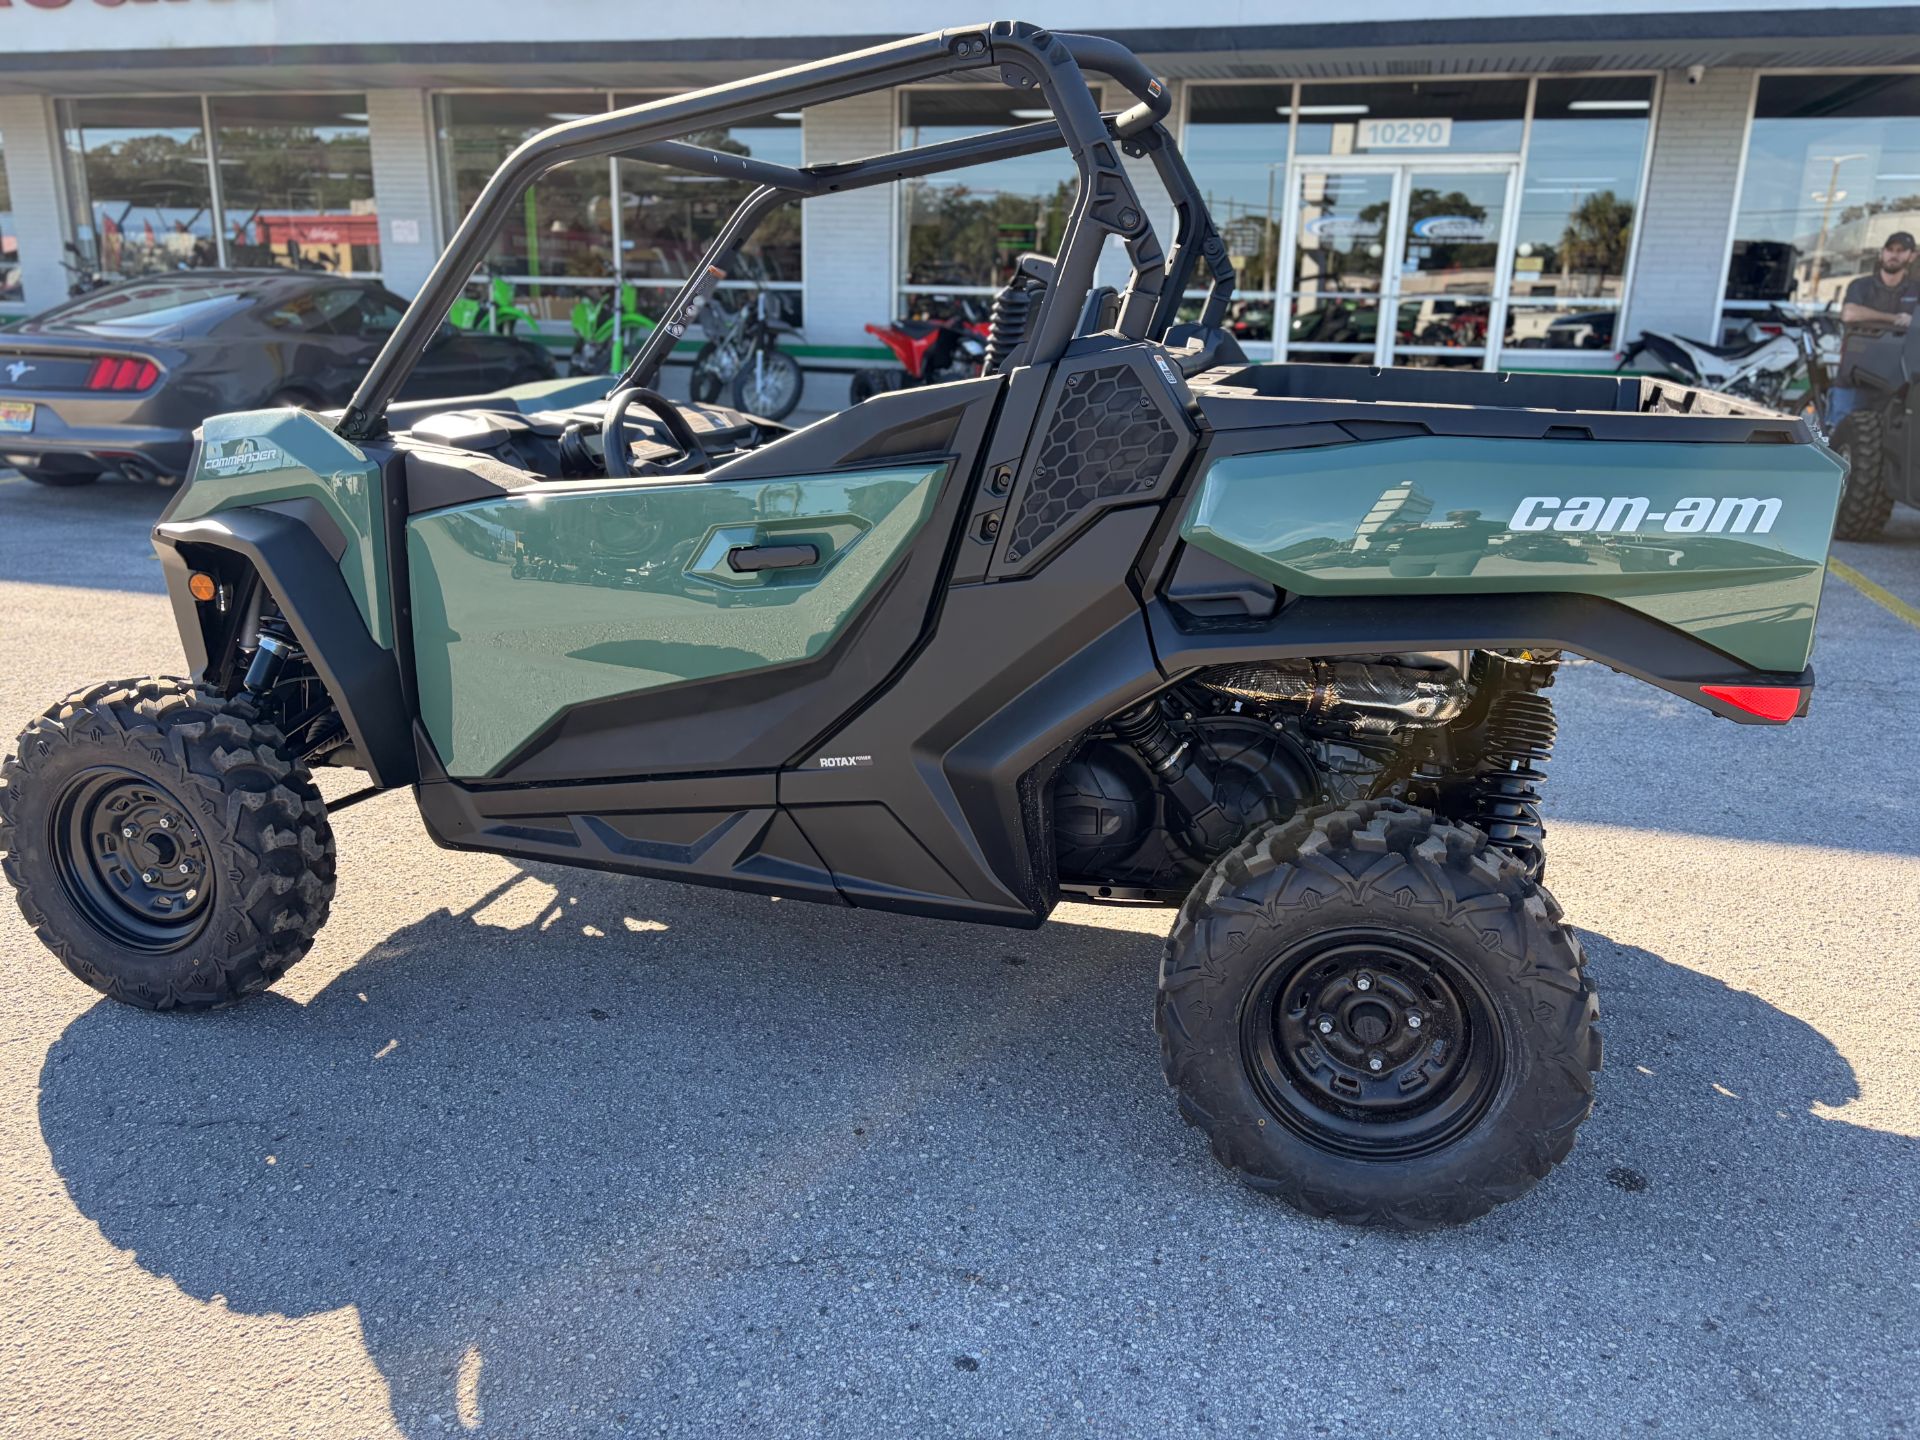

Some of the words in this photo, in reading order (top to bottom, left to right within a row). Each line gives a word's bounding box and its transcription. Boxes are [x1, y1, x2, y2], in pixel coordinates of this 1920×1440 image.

[1368, 122, 1442, 144] 10290
[204, 449, 277, 469] COMMANDER
[1508, 496, 1783, 533] can-am
[819, 756, 857, 767] ROTAX
